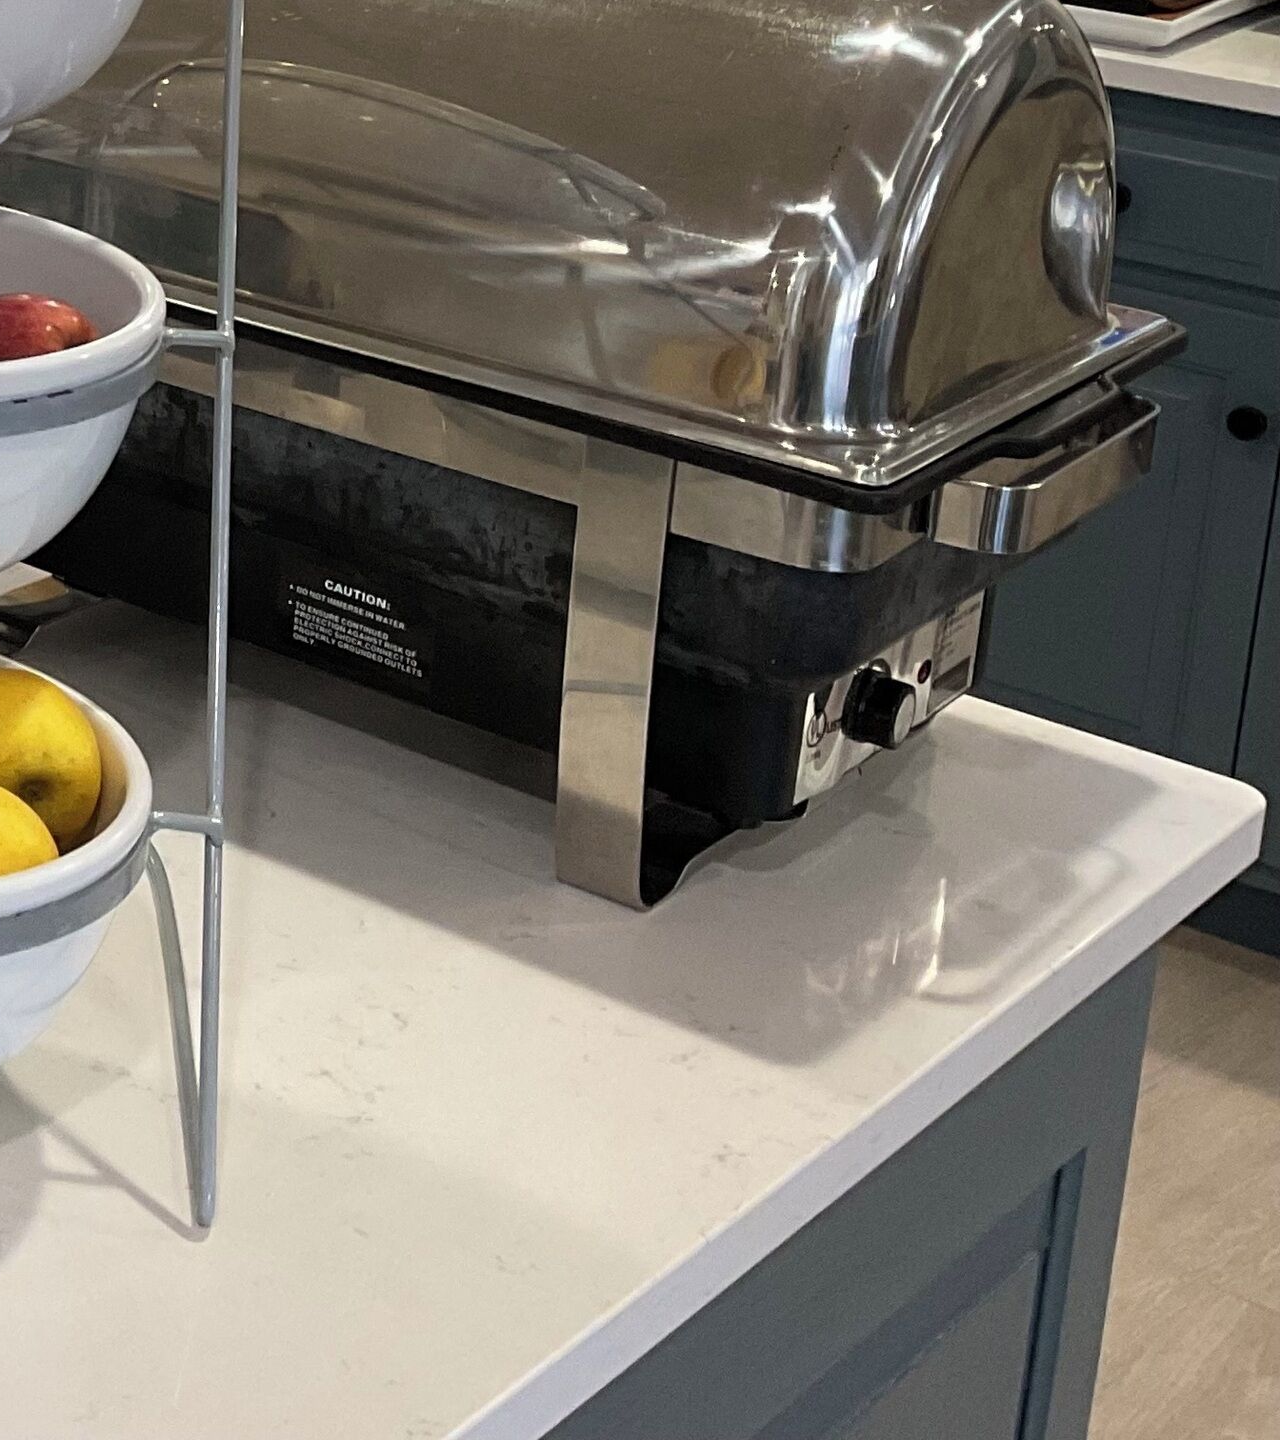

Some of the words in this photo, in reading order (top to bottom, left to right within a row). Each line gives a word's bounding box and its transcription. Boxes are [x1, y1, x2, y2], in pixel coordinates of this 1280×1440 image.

[294, 616, 333, 637] ELECTRIC
[406, 657, 417, 667] TO
[295, 609, 346, 633] PROTECTION
[293, 624, 336, 645] PROPERLY
[384, 658, 422, 678] OUTLETS
